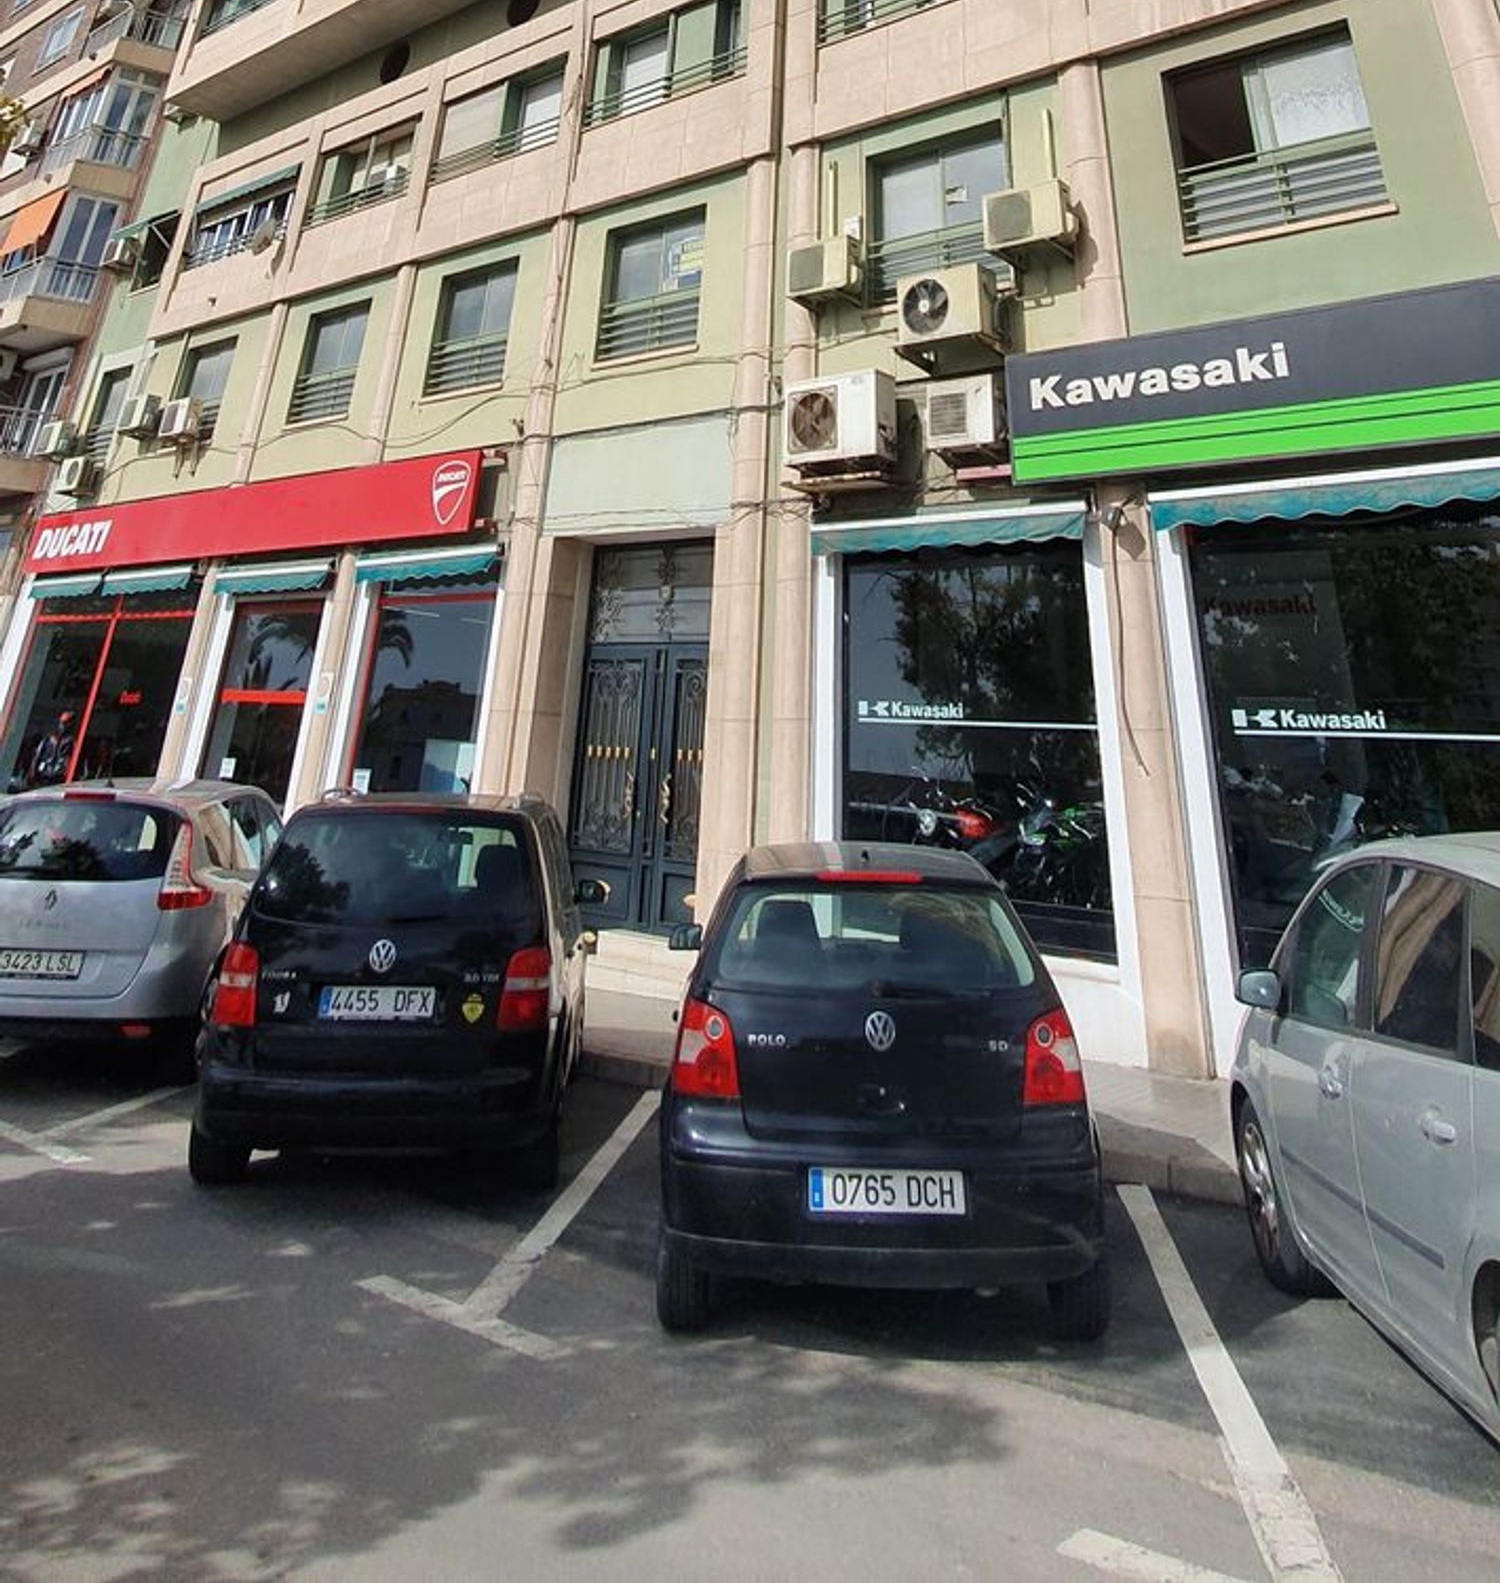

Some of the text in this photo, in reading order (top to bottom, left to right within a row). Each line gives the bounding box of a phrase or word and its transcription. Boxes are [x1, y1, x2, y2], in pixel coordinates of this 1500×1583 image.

[1029, 342, 1290, 411] Kawasaki
[437, 470, 466, 483] DUCATI
[32, 519, 113, 560] DUCATI
[891, 700, 964, 719] Kawasaki
[1280, 709, 1386, 730] Kawasaki
[2, 953, 75, 972] 3423 LSL
[331, 990, 431, 1013] 4455 DFX
[747, 1033, 787, 1046] POLO
[832, 1173, 956, 1208] 0765 DCH
